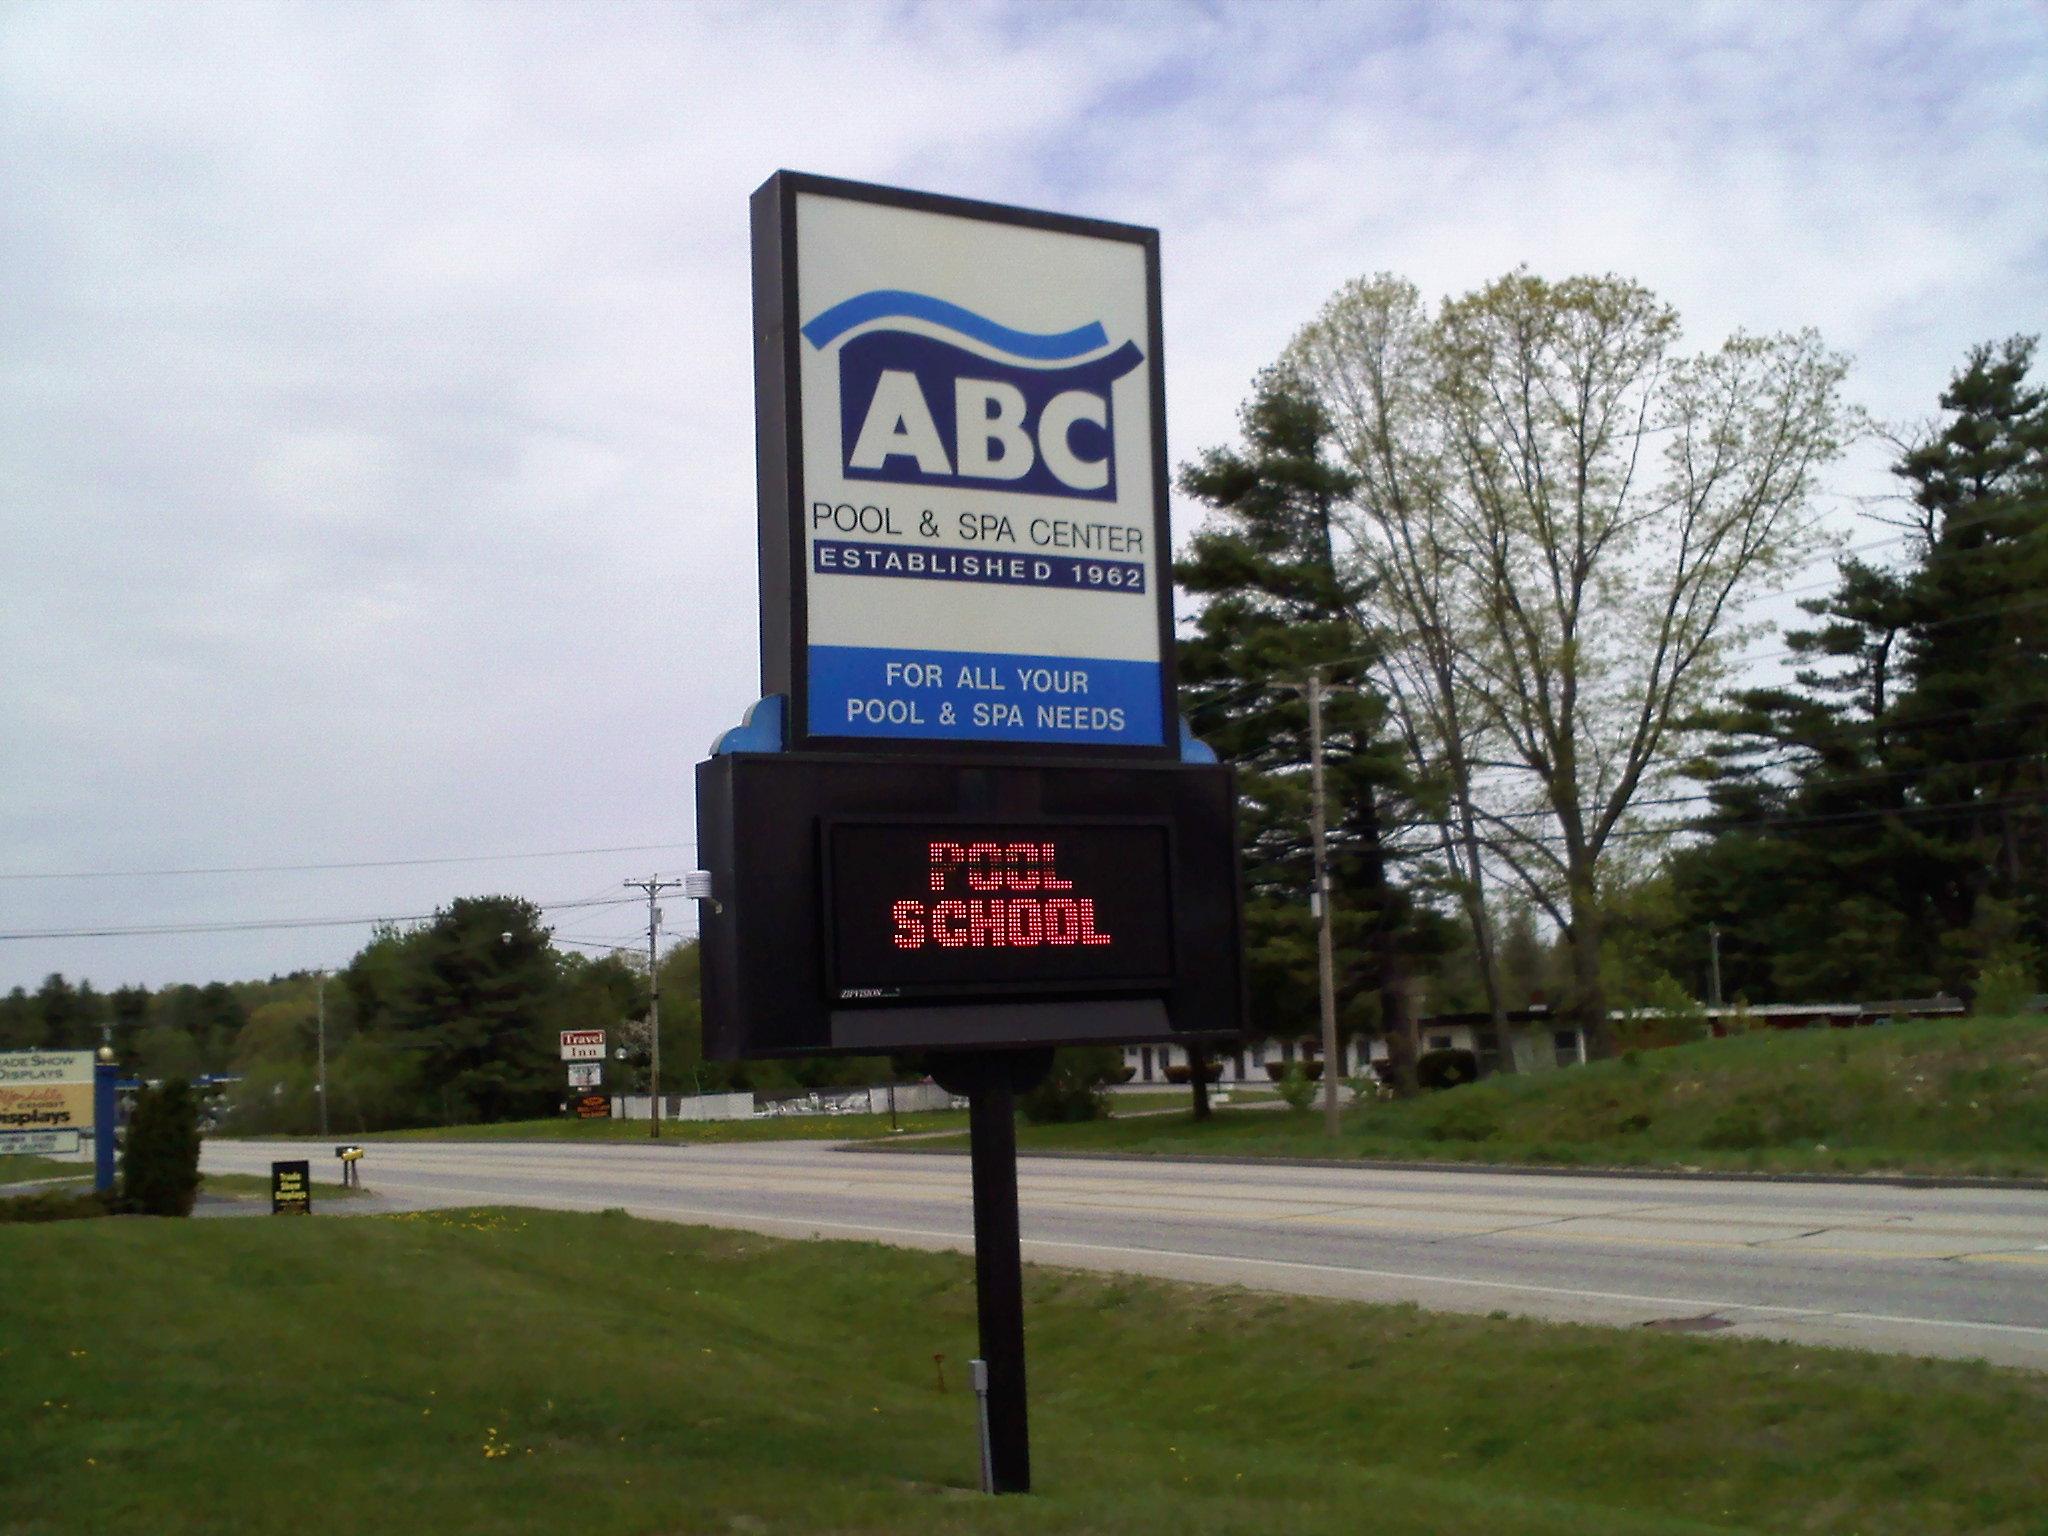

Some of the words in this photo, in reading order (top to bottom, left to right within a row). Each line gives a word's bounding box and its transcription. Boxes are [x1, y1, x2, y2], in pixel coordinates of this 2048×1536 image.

[849, 369, 1109, 490] ABC
[813, 502, 902, 535] POOL
[919, 510, 940, 538] &
[959, 512, 1016, 543] SPA
[1030, 518, 1143, 553] CENTER
[819, 548, 1052, 581] ESTABLISHED
[1071, 564, 1142, 588] 1962
[886, 662, 943, 688] FOR
[956, 665, 1005, 690] ALL
[1017, 668, 1088, 694] YOUR
[847, 698, 924, 724] POOL
[939, 703, 956, 726] &
[973, 704, 1024, 728] SPA
[1037, 707, 1126, 731] NEEDS
[929, 842, 1073, 891] POOL
[893, 897, 1112, 949] SCHOOL
[566, 1032, 603, 1044] Travel
[572, 1047, 597, 1057] Inn
[0, 1109, 70, 1125] isplays
